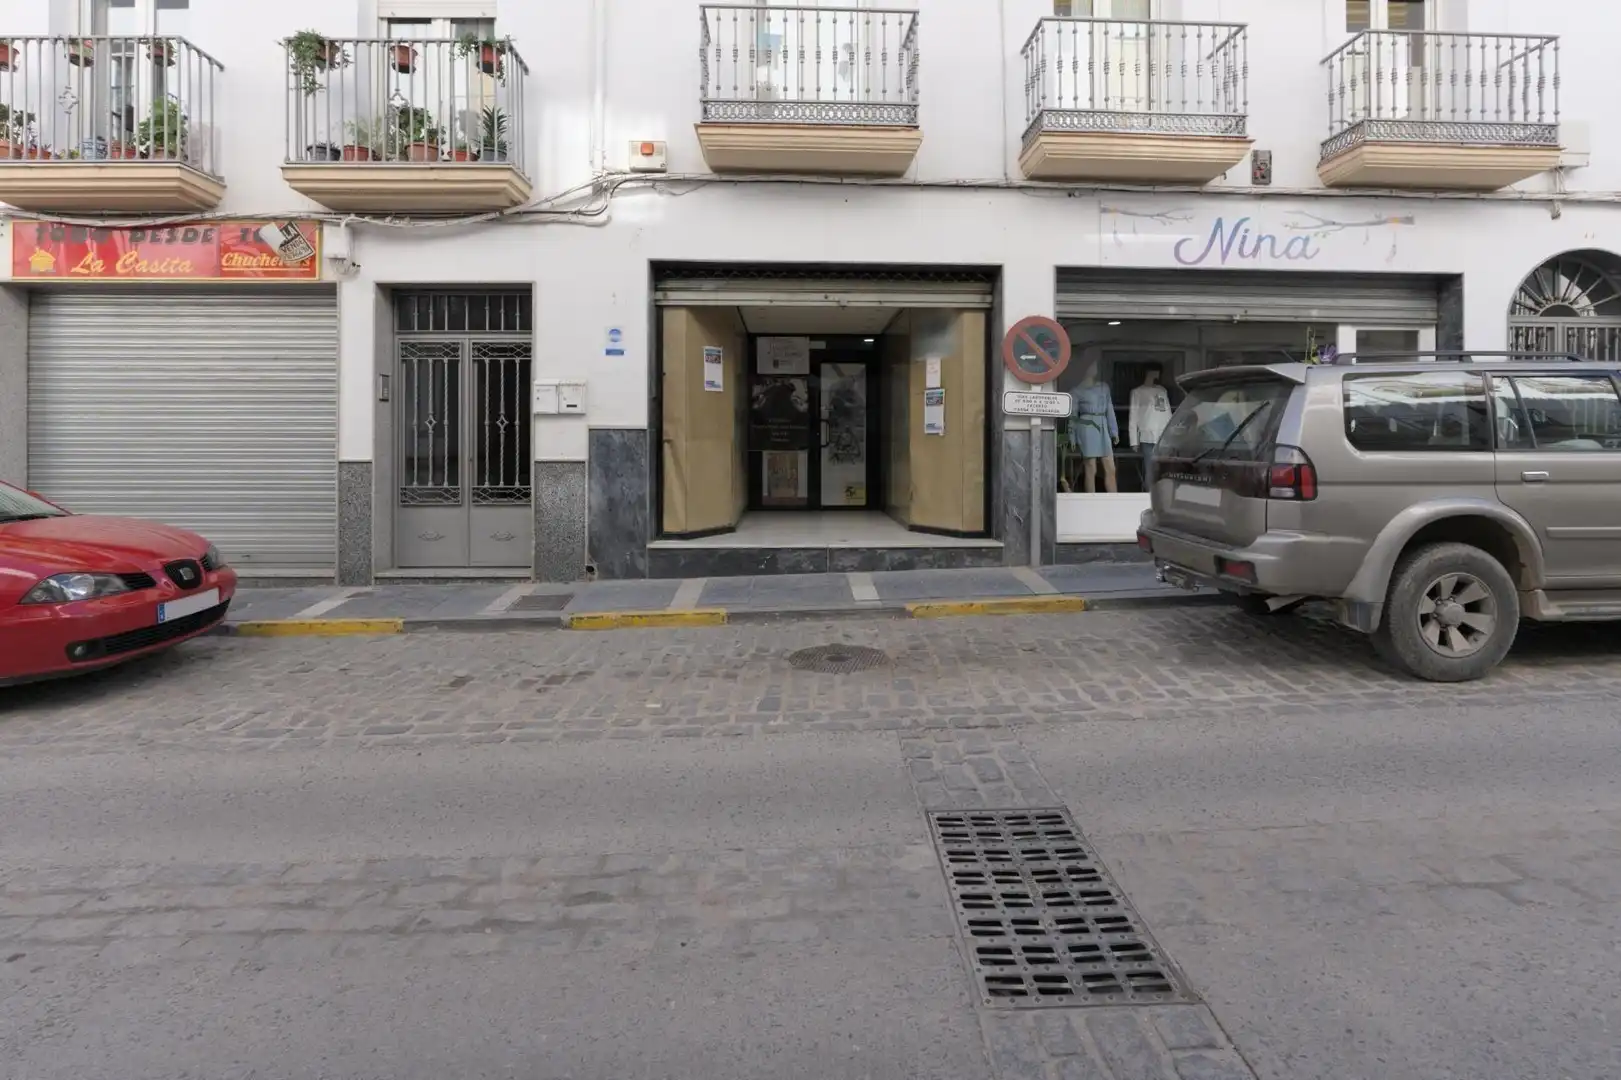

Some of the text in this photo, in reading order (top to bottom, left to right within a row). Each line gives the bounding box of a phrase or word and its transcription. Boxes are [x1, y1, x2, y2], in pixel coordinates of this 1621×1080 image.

[129, 227, 216, 243] DESDE
[1173, 216, 1320, 265] Nina
[70, 250, 194, 274] La Casita
